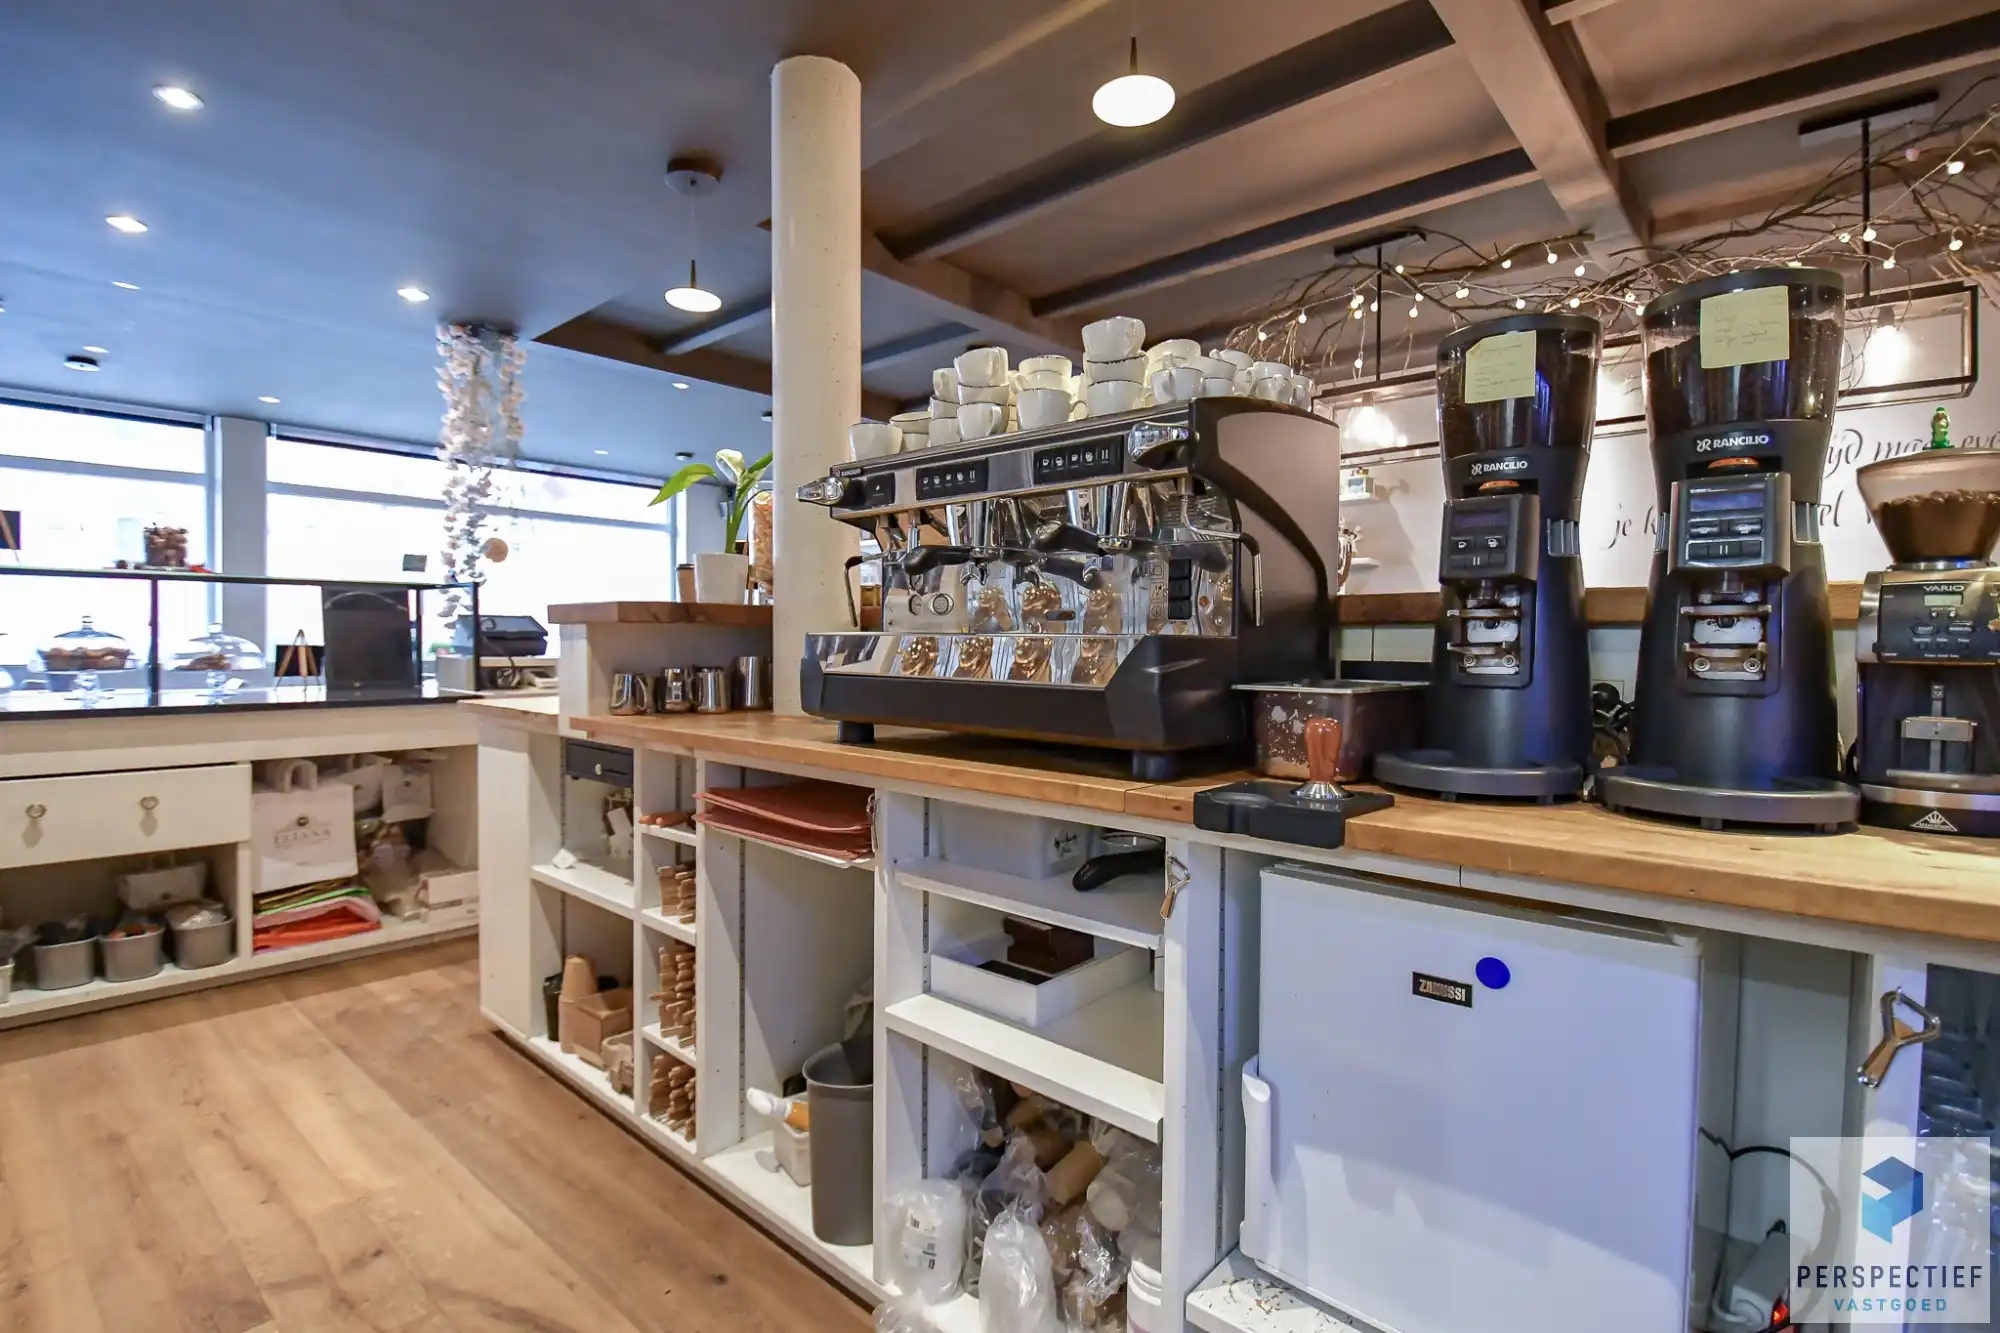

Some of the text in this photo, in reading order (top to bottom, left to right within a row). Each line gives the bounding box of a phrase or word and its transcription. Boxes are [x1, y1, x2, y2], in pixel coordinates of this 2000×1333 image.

[1713, 434, 1770, 448] RANCILIO
[1483, 460, 1528, 472] RANCILIO
[1923, 584, 1965, 592] VARIO
